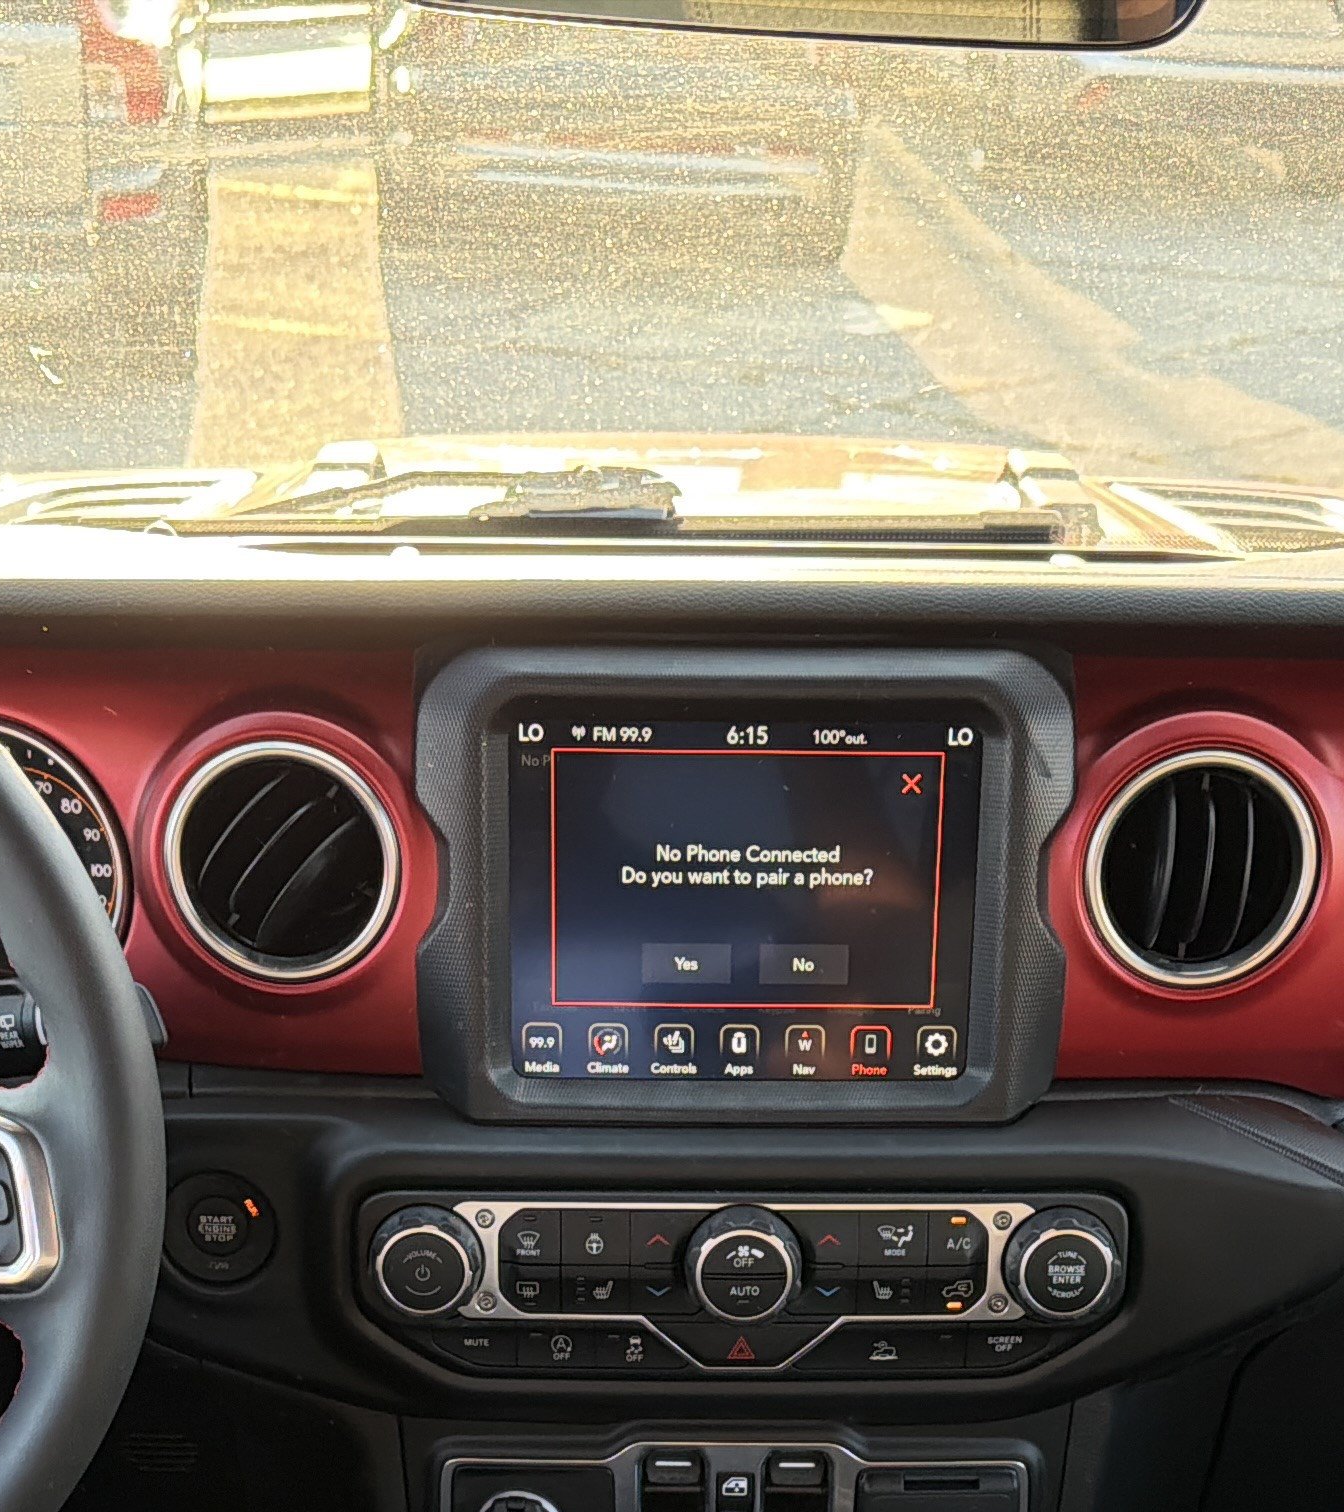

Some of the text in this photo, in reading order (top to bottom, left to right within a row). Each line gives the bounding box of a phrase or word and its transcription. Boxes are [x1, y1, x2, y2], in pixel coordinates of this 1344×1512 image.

[517, 723, 544, 741] LO
[592, 726, 653, 743] FM 99.9
[726, 725, 769, 745] 6:15
[947, 728, 973, 745] LO
[60, 798, 83, 815] 80
[83, 828, 102, 843] 90
[656, 843, 841, 863] No Phone Connected
[90, 863, 113, 878] 100
[621, 866, 874, 889] Do you want to pair a phone?
[674, 957, 699, 971] Yes
[792, 957, 815, 972] No
[528, 1036, 556, 1049] 99.9
[797, 1040, 812, 1052] W
[524, 1061, 560, 1073] Media
[586, 1062, 630, 1074] Climate
[650, 1062, 698, 1075] Controls
[724, 1062, 754, 1077] Apps
[792, 1063, 816, 1075] Nav
[851, 1064, 888, 1076] Phone
[913, 1064, 958, 1078] Settings
[199, 1215, 234, 1223] START
[204, 1234, 234, 1242] STOP
[946, 1238, 972, 1251] A/C
[406, 1249, 438, 1261] VOLUME
[516, 1248, 540, 1257] FRONT
[884, 1248, 907, 1257] MODE
[1057, 1251, 1079, 1260] TUNE
[733, 1257, 755, 1268] OFF
[1048, 1264, 1086, 1274] BROWSE
[1052, 1275, 1082, 1285] ENTER
[729, 1286, 760, 1297] AUTO
[1051, 1286, 1081, 1299] SCROLL
[463, 1337, 490, 1348] MUTE
[987, 1335, 1023, 1345] SCREEN
[994, 1343, 1013, 1353] OFF
[552, 1352, 571, 1362] OFF
[625, 1353, 644, 1363] OFF
